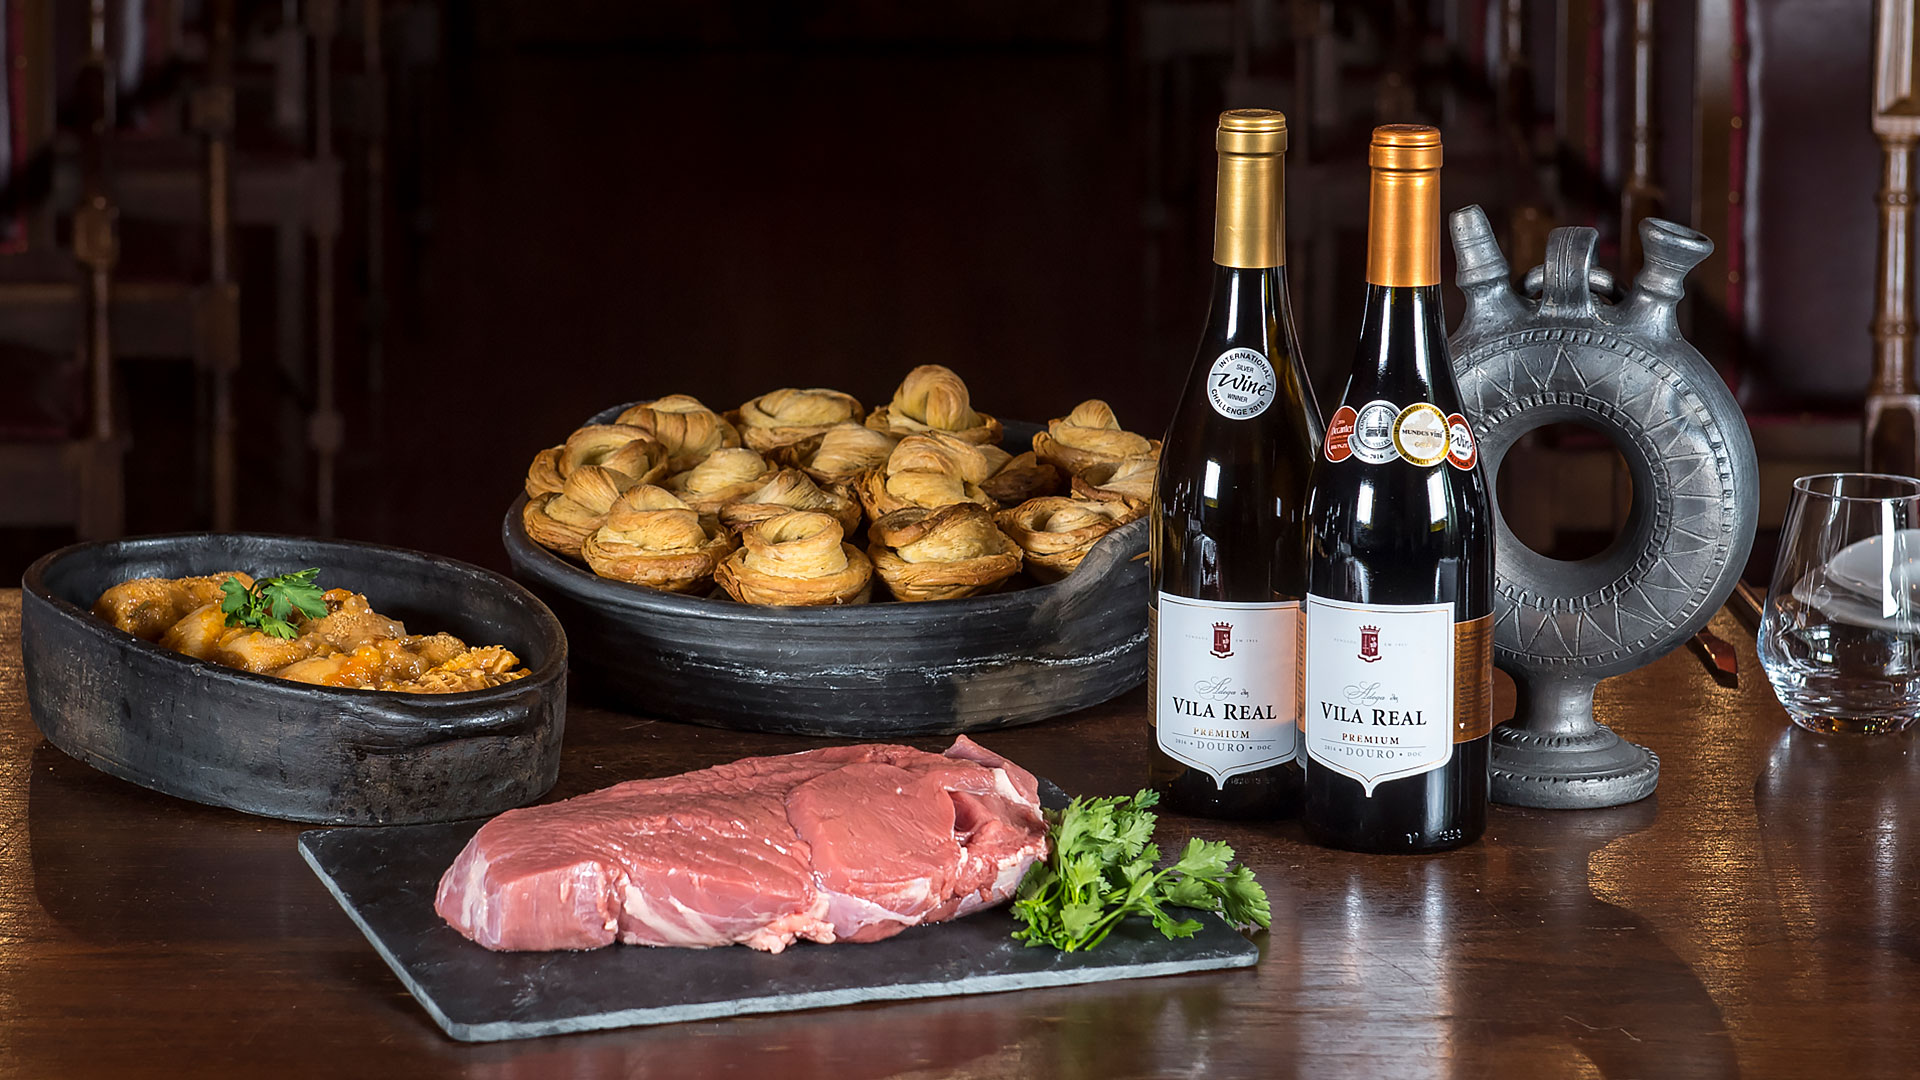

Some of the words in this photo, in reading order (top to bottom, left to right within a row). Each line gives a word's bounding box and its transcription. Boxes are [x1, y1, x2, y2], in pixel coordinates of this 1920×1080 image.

[1218, 352, 1271, 380] INTERNATIONAL
[1236, 363, 1255, 374] SILVER
[1212, 373, 1274, 397] Wine
[1211, 388, 1248, 416] CHALLENGE
[1249, 400, 1266, 414] 2018
[1227, 392, 1248, 404] WINNER
[1402, 429, 1430, 437] MUNDUS
[1172, 696, 1216, 719] VILA
[1223, 703, 1277, 721] REAL
[1321, 701, 1364, 724] VILA
[1371, 708, 1428, 727] REAL
[1193, 727, 1251, 739] PREMIUM
[1341, 732, 1400, 745] PREMIUM
[1197, 740, 1245, 752] DOURO
[1346, 746, 1395, 759] DOURO
